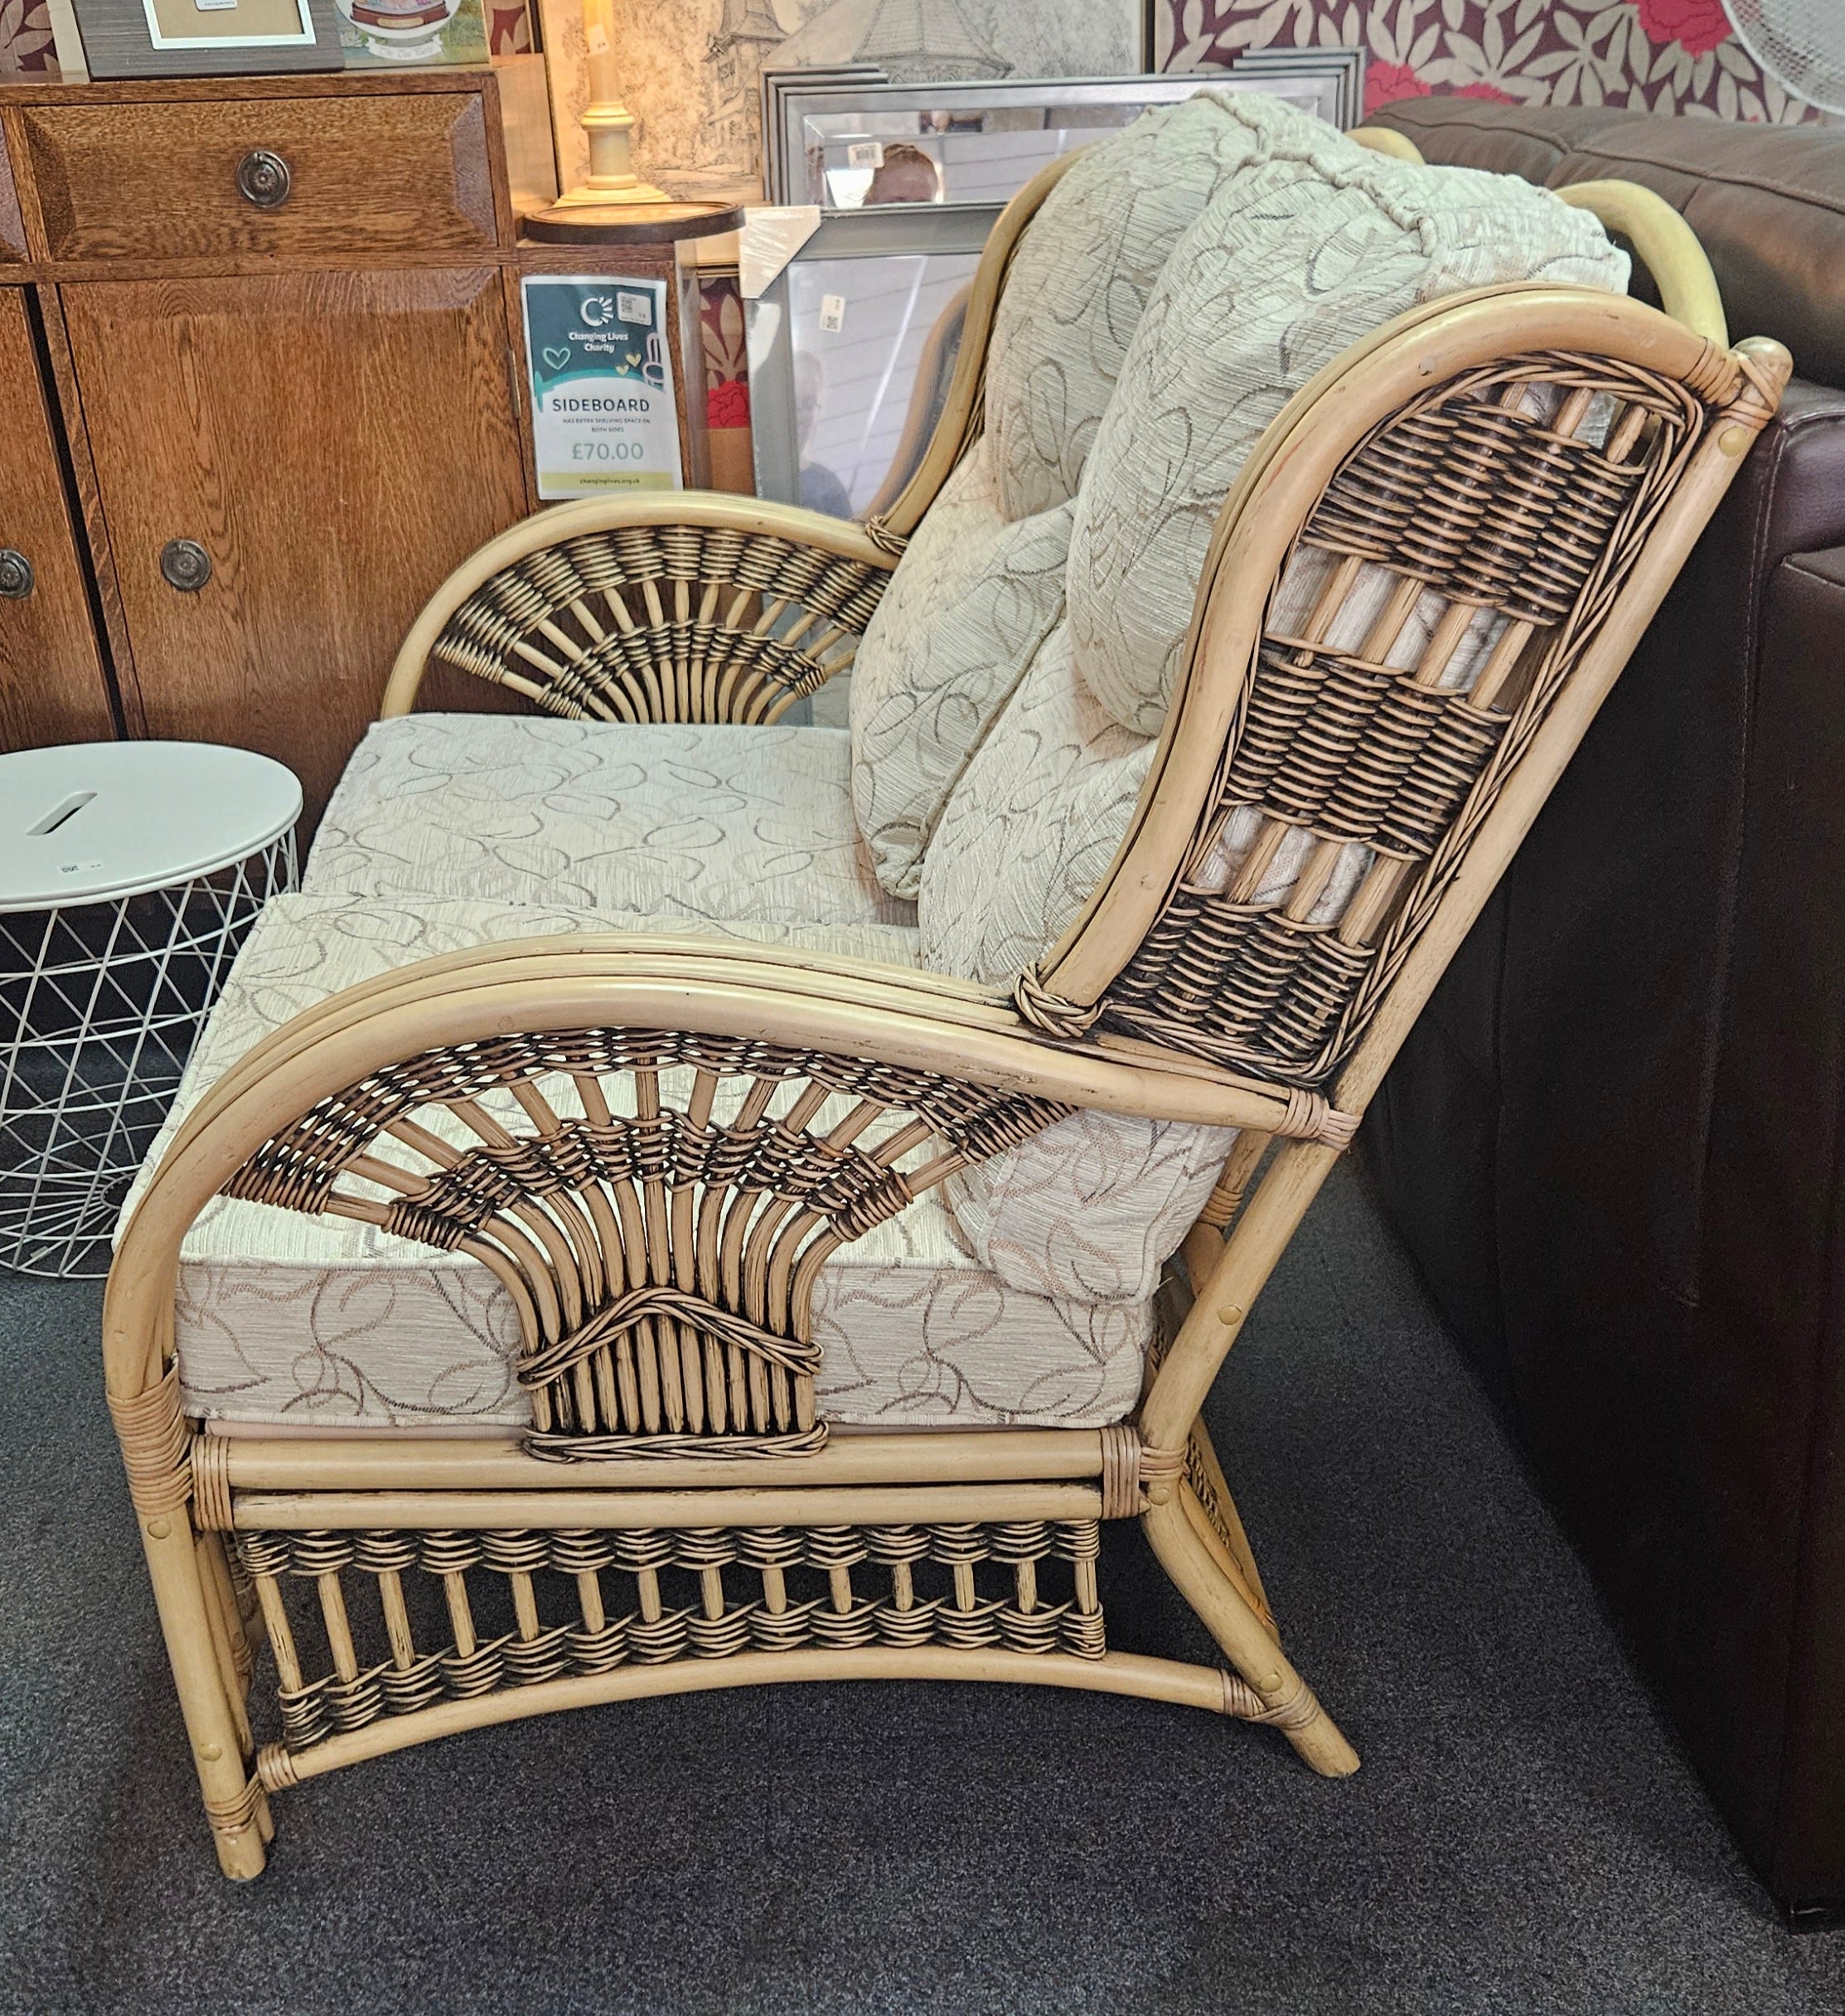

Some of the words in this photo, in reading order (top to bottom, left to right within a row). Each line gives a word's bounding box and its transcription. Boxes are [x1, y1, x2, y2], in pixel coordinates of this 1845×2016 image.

[569, 332, 607, 343] Changing
[608, 332, 629, 342] Lives
[584, 342, 615, 354] Charity
[553, 399, 650, 412] SIDEBOARD
[572, 443, 644, 461] £70.00
[579, 477, 640, 486] changinglives.org.uk
